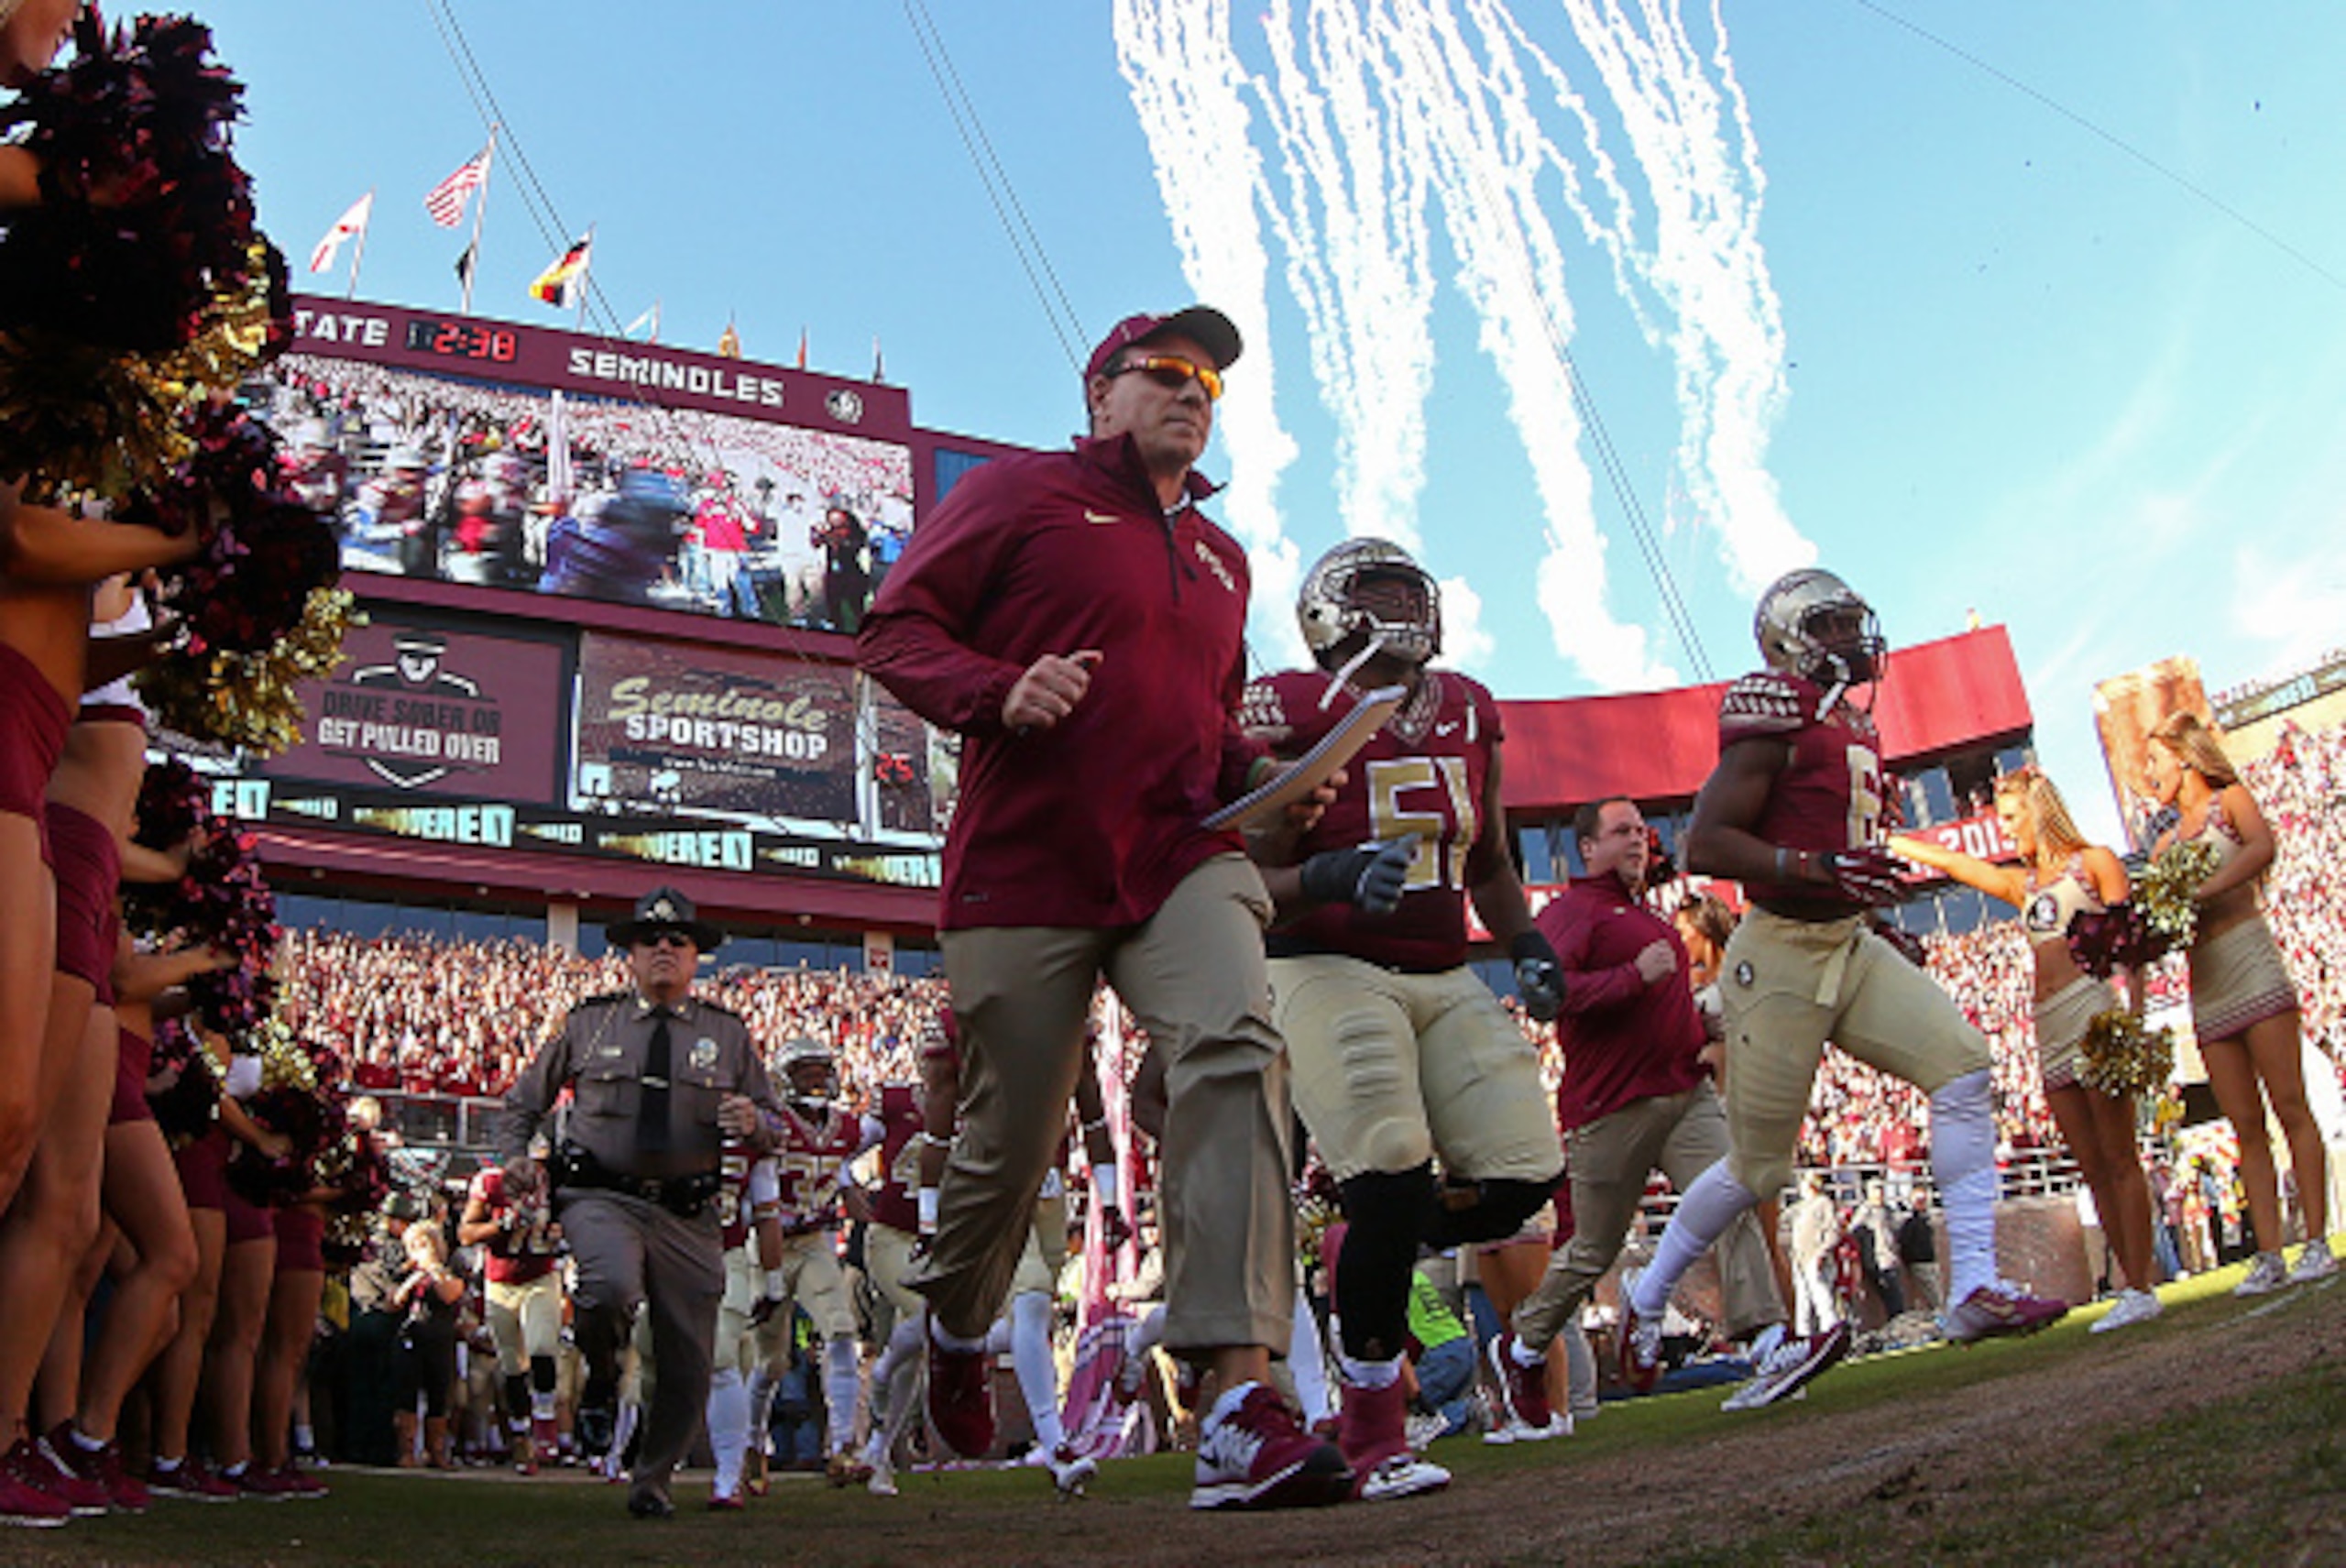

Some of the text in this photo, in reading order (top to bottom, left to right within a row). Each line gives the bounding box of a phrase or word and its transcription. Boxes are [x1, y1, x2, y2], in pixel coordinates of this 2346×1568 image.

[568, 347, 785, 407] SEMINOLES
[323, 692, 389, 721] DRIVE
[393, 699, 466, 731] SOBER
[608, 676, 828, 731] Seminole
[318, 718, 500, 764] GET PULLED OVER
[625, 714, 828, 760] SPORTSHOP
[875, 752, 914, 781] 25
[1357, 756, 1474, 891] 51
